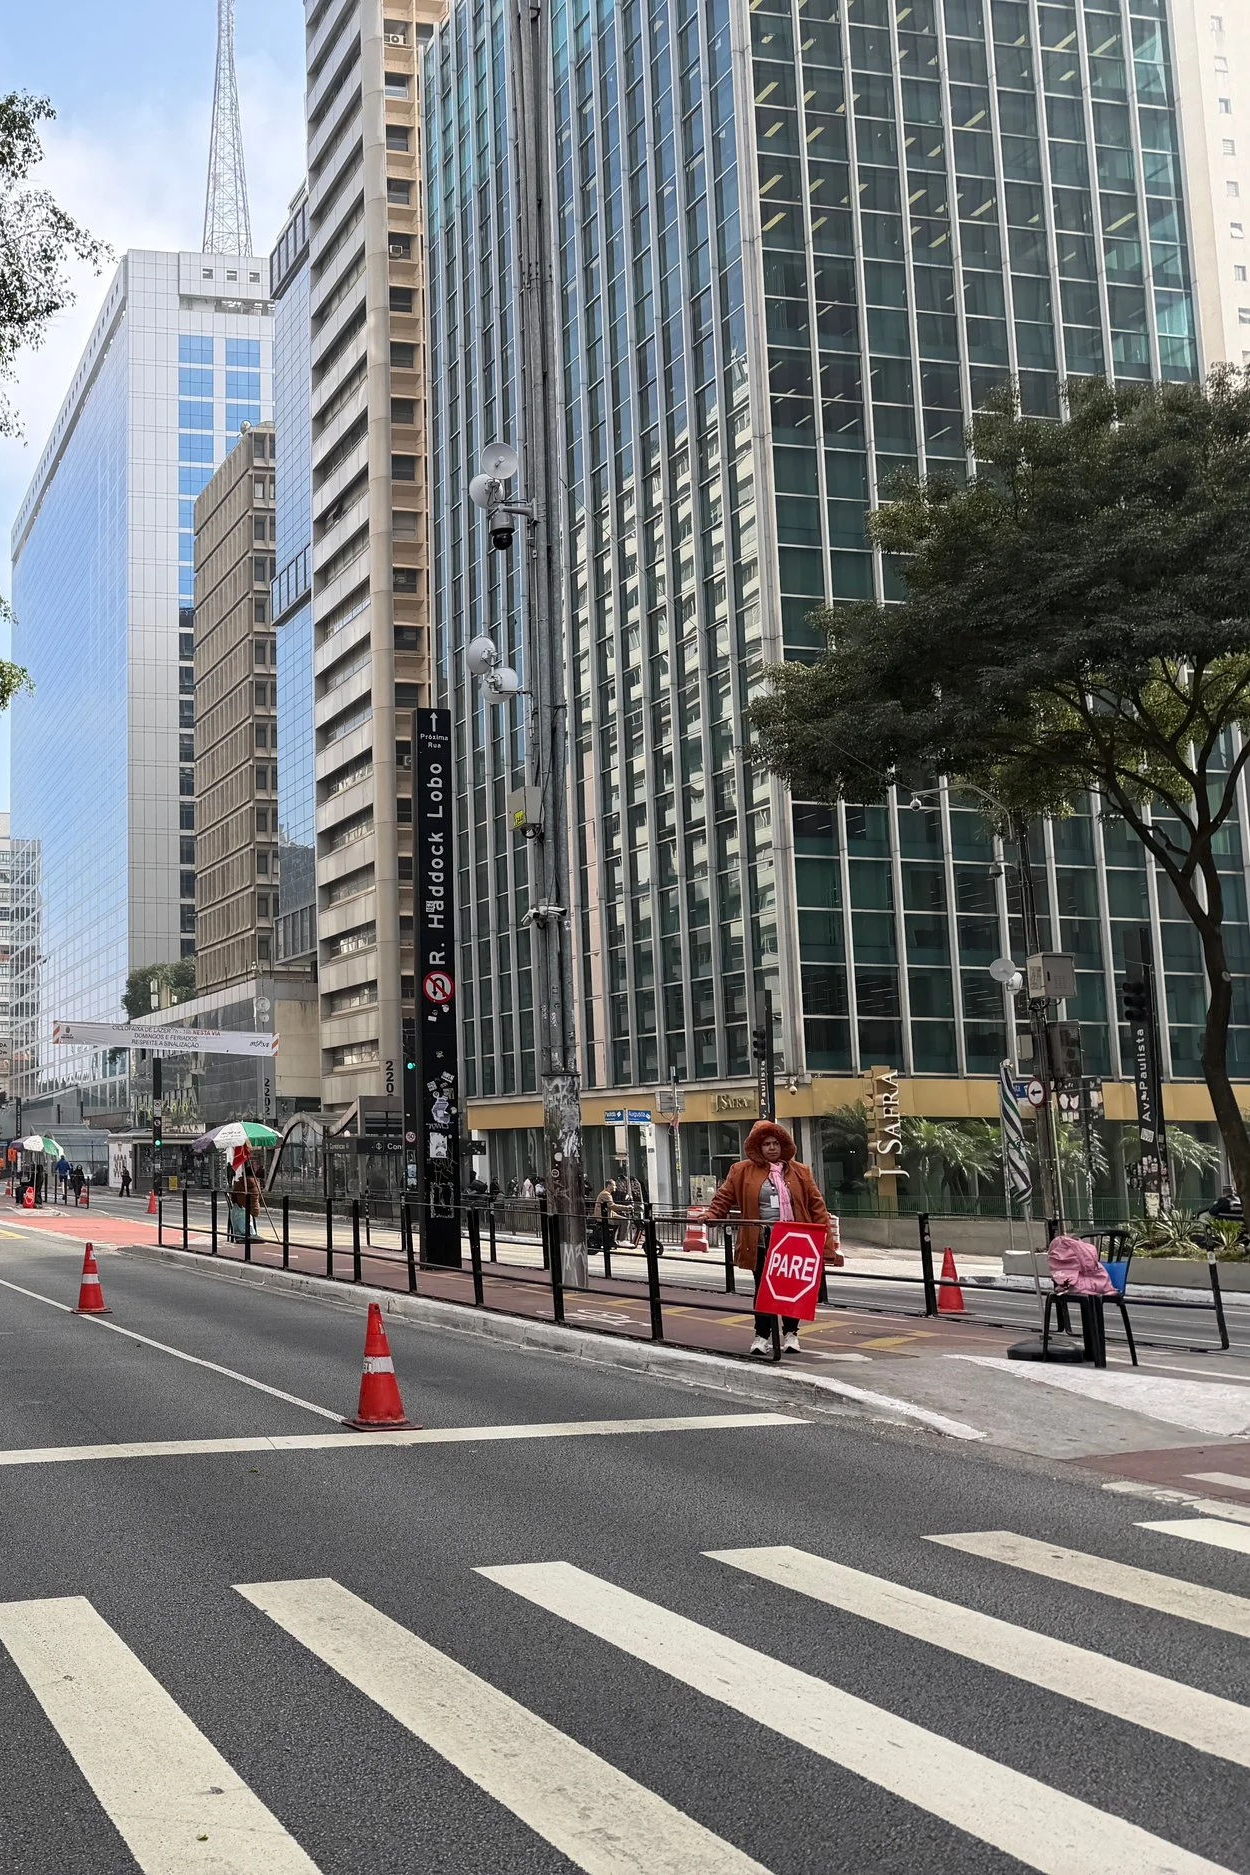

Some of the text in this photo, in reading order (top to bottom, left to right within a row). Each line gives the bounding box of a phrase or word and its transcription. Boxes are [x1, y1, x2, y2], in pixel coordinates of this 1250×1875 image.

[420, 733, 448, 741] Próxima
[426, 763, 446, 965] R. Haddock Lobo
[385, 1060, 394, 1096] 220
[1136, 1028, 1152, 1122] Av. Paulista
[876, 1069, 903, 1155] SAFRA
[769, 1252, 816, 1282] PARE
